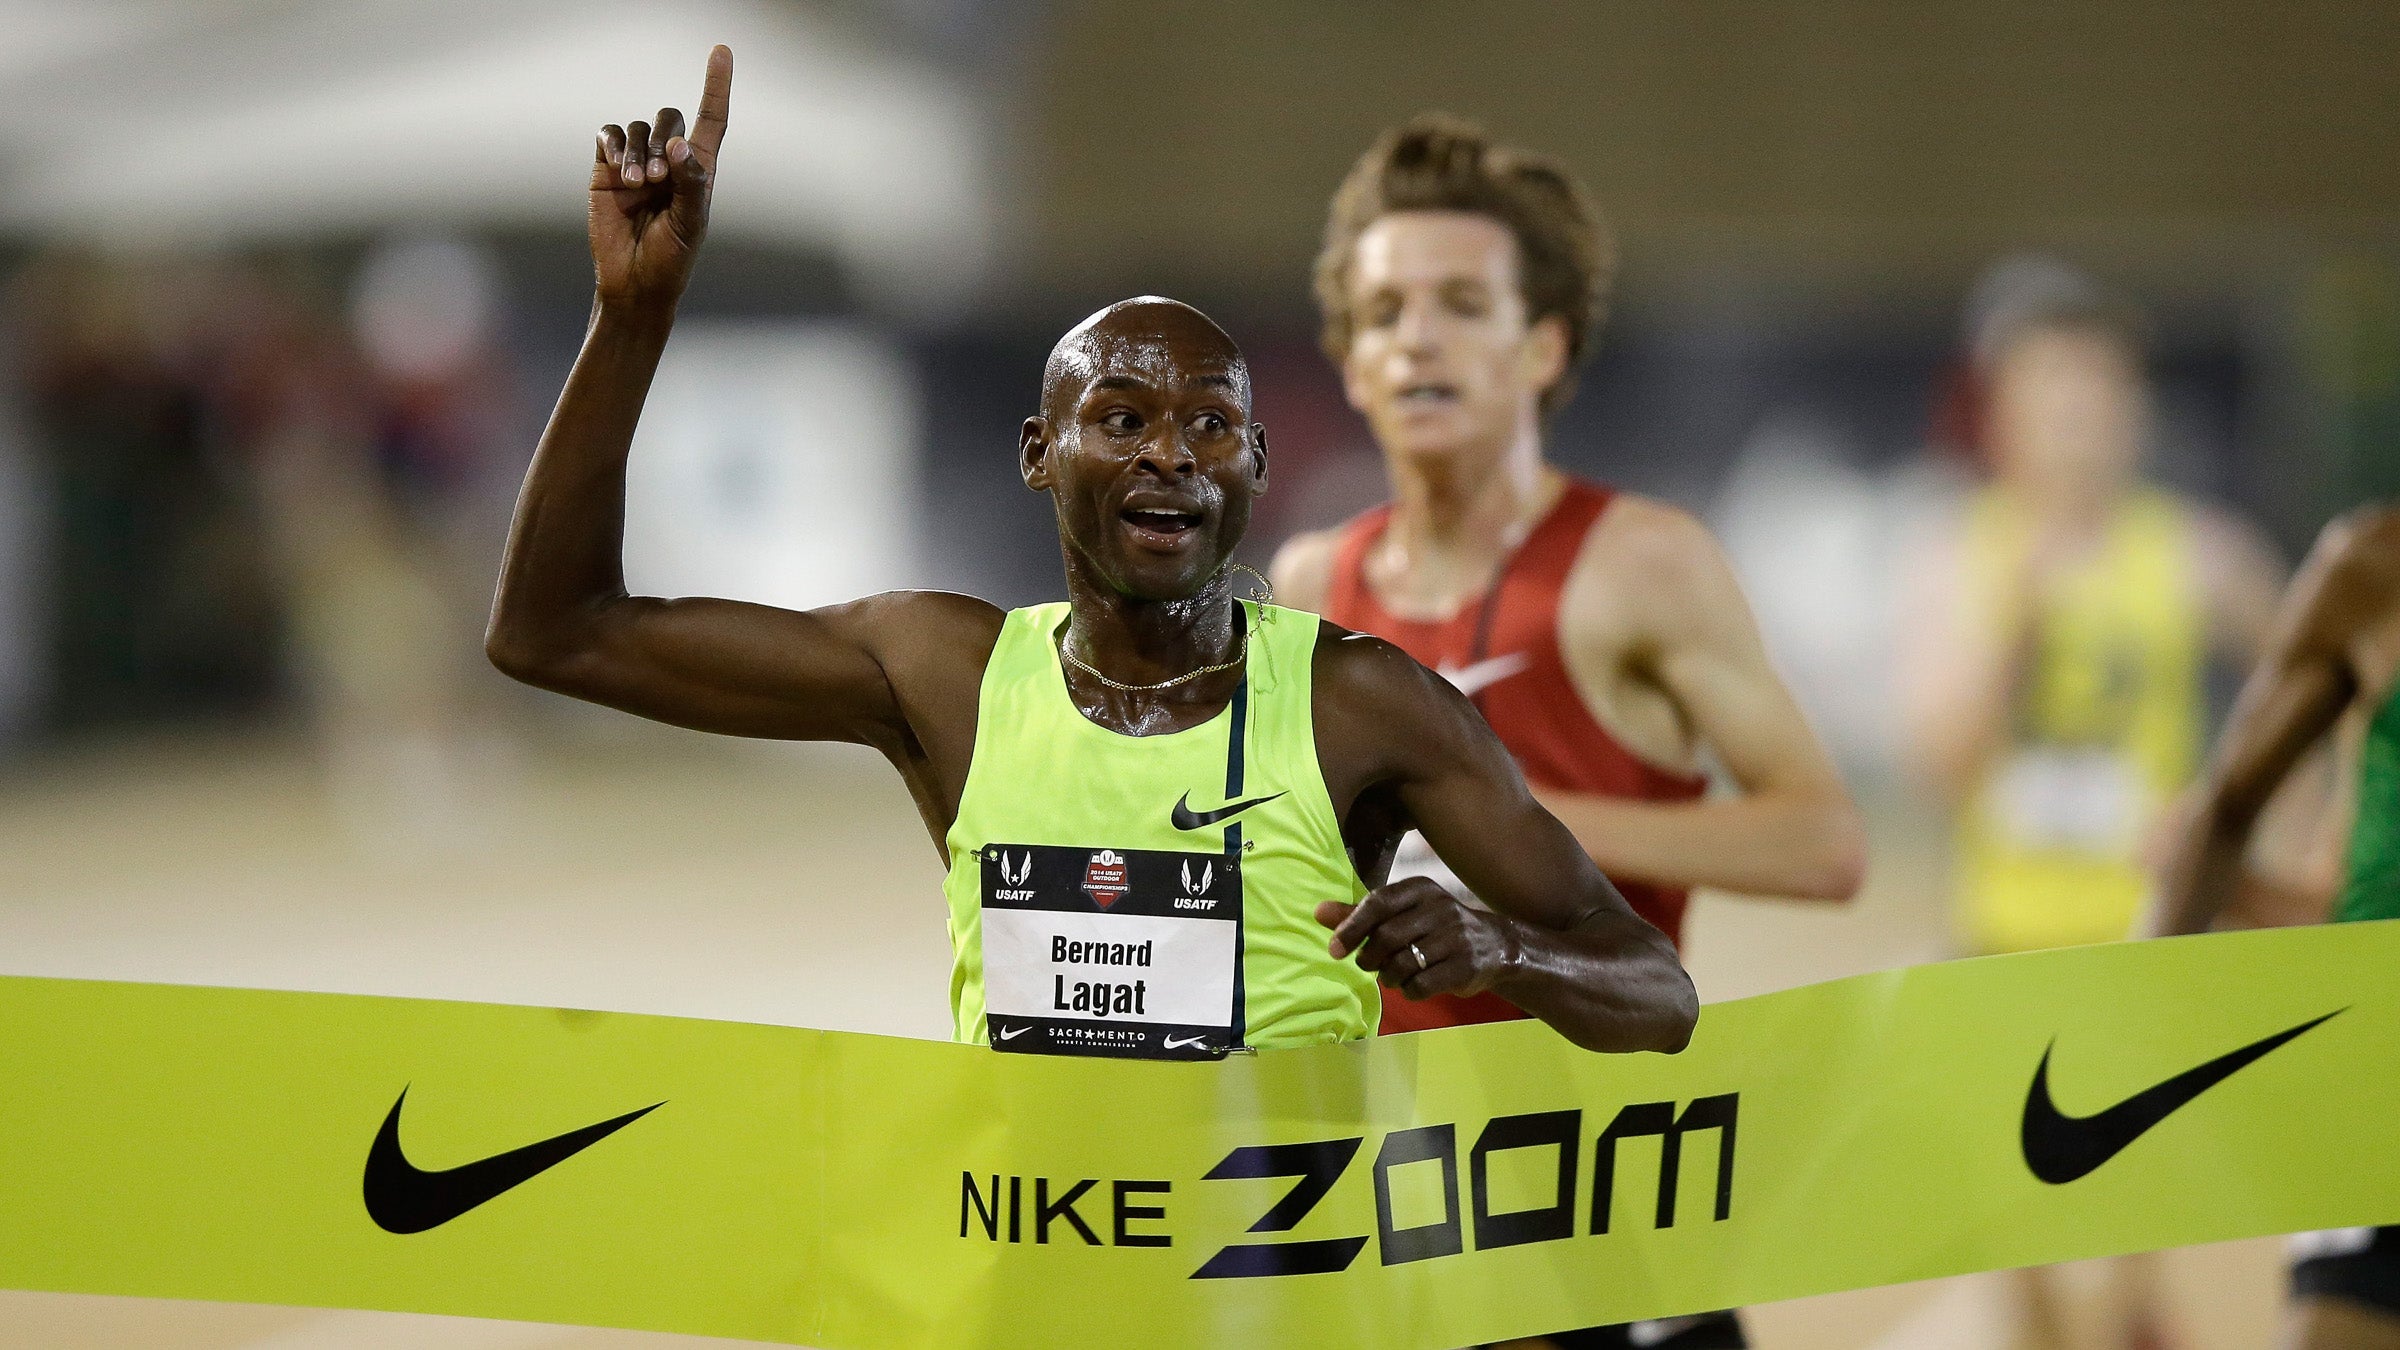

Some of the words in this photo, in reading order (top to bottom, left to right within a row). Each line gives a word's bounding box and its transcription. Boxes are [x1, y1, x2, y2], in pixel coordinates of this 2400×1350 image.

[995, 889, 1035, 900] USATF
[1173, 897, 1217, 910] USATF
[1051, 935, 1153, 967] Bernard
[1054, 974, 1146, 1017] Lagat
[960, 1171, 1172, 1248] NIKE
[1188, 1092, 1740, 1280] ZOOM
